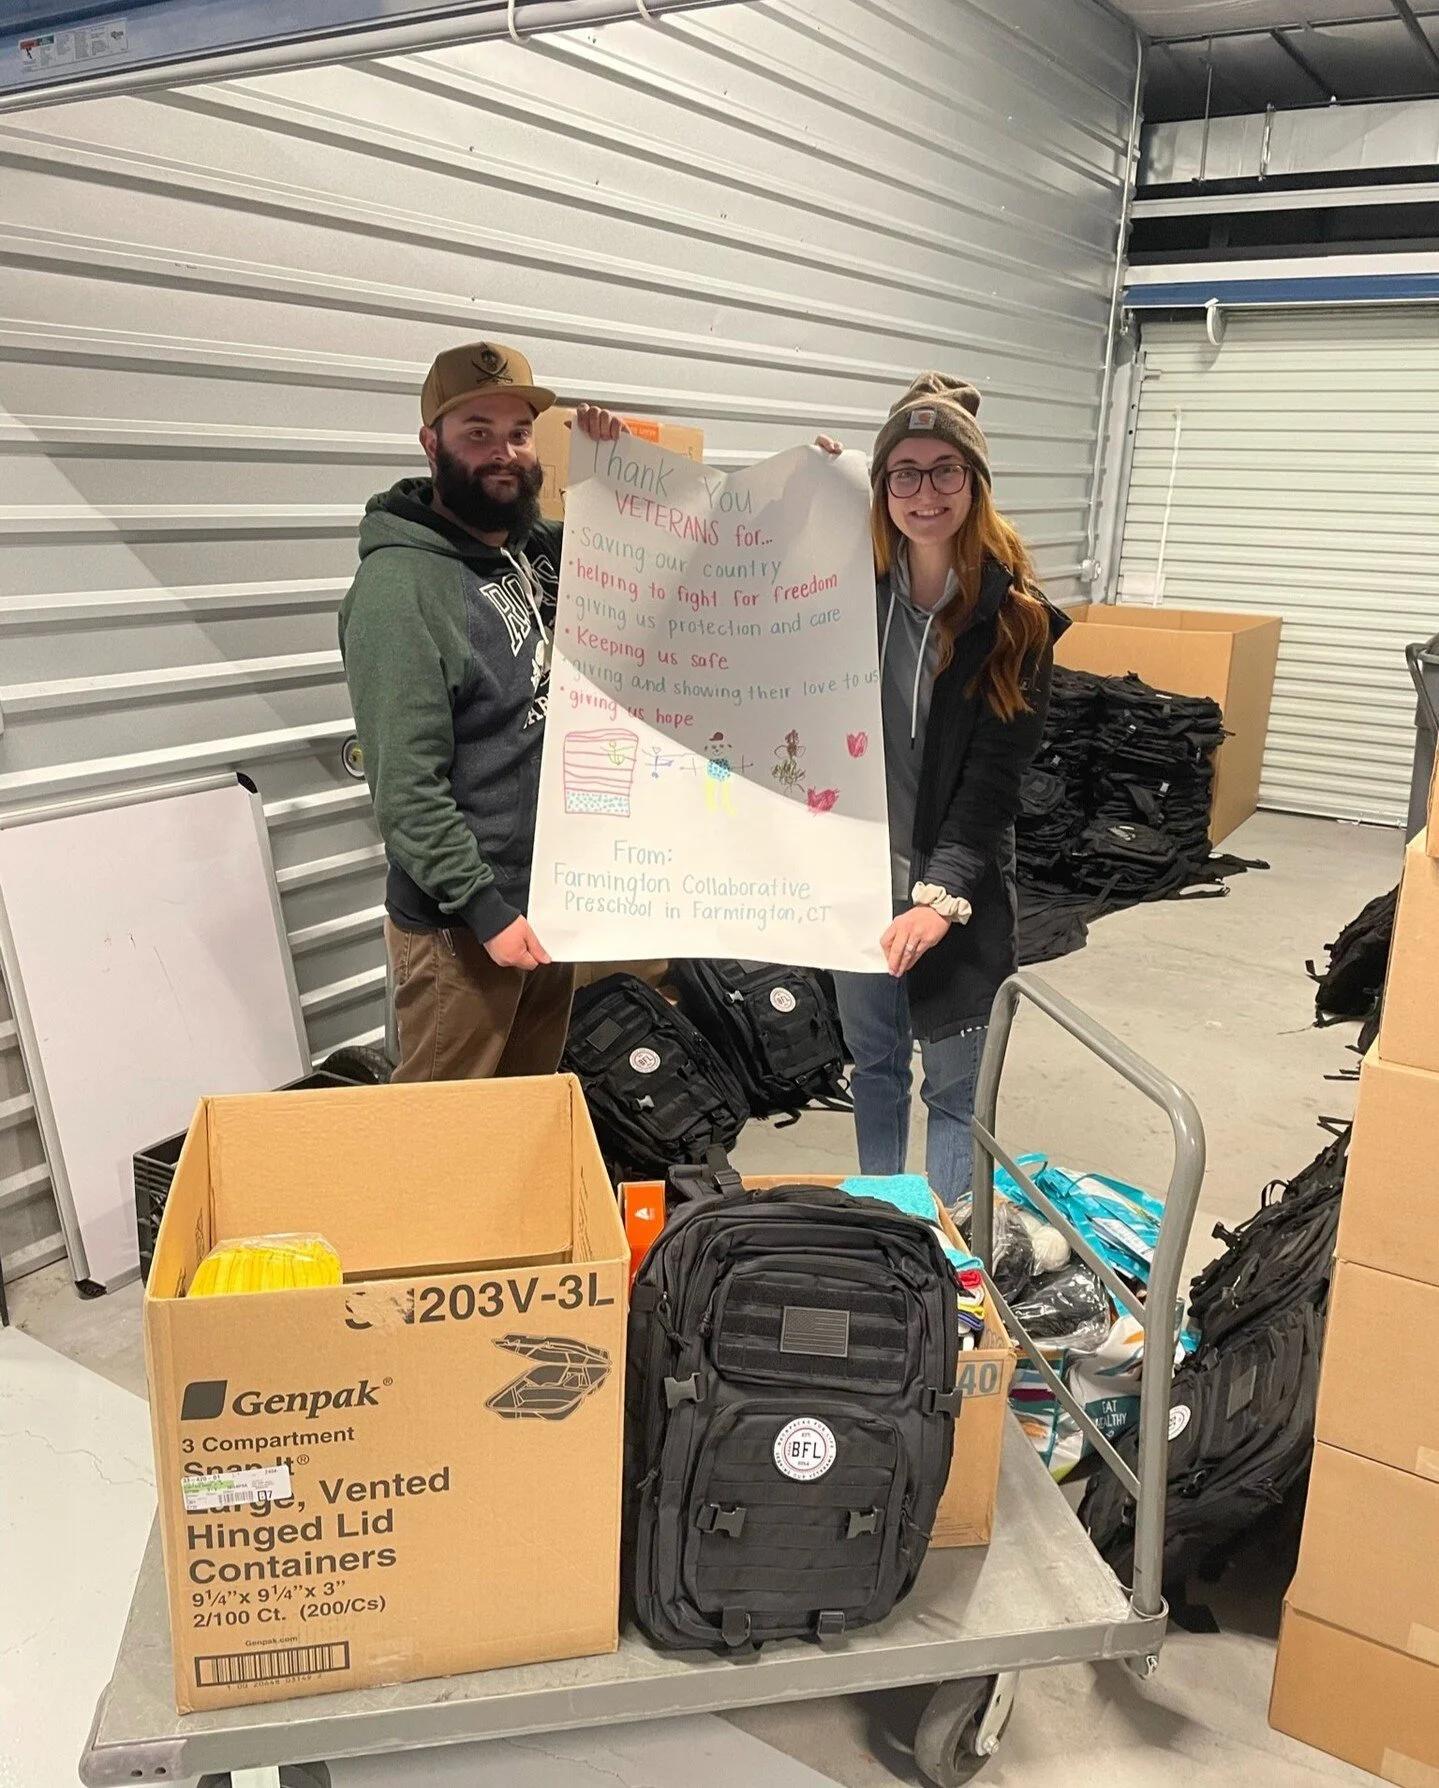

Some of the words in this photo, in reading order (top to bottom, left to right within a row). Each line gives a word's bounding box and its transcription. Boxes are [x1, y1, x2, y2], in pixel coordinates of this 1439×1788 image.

[593, 440, 674, 497] Thank
[704, 475, 752, 514] You
[615, 490, 719, 547] VETERANS
[582, 527, 645, 574] Saving
[656, 551, 687, 573] our
[703, 560, 782, 584] country
[577, 558, 638, 601] helping
[649, 582, 665, 600] to
[677, 582, 718, 612] fight
[734, 582, 760, 606] for
[774, 573, 838, 601] freedom
[575, 596, 627, 630] giving
[637, 611, 656, 629] us
[668, 611, 762, 639] protection
[770, 607, 801, 634] and
[810, 607, 841, 624] care
[577, 627, 645, 667] Keeping
[658, 649, 678, 665] us
[691, 652, 729, 670] safe
[572, 657, 623, 691] giving
[632, 671, 666, 693] and
[674, 679, 741, 706] showing
[749, 679, 791, 700] their
[803, 671, 837, 696] love
[843, 672, 859, 691] to
[865, 669, 880, 684] us
[569, 689, 618, 721] giving
[628, 706, 645, 720] us
[656, 708, 694, 729] hope
[613, 839, 672, 867] From:
[553, 861, 670, 902] Farmington
[683, 874, 811, 900] Collaborative
[564, 890, 652, 918] Preschool
[665, 900, 680, 919] in
[958, 1363, 998, 1395] 40
[182, 1438, 195, 1454] 3
[202, 1426, 355, 1453] Compartment
[792, 1441, 821, 1459] BFL
[318, 1466, 450, 1505] Vented
[187, 1515, 323, 1553] Hinged
[337, 1508, 394, 1538] Lid
[189, 1547, 397, 1585] Containers
[193, 1610, 250, 1628] 2/100
[257, 1607, 287, 1623] Ct.
[300, 1595, 387, 1623] (200/Cs)
[245, 1636, 298, 1648] Genpak.com
